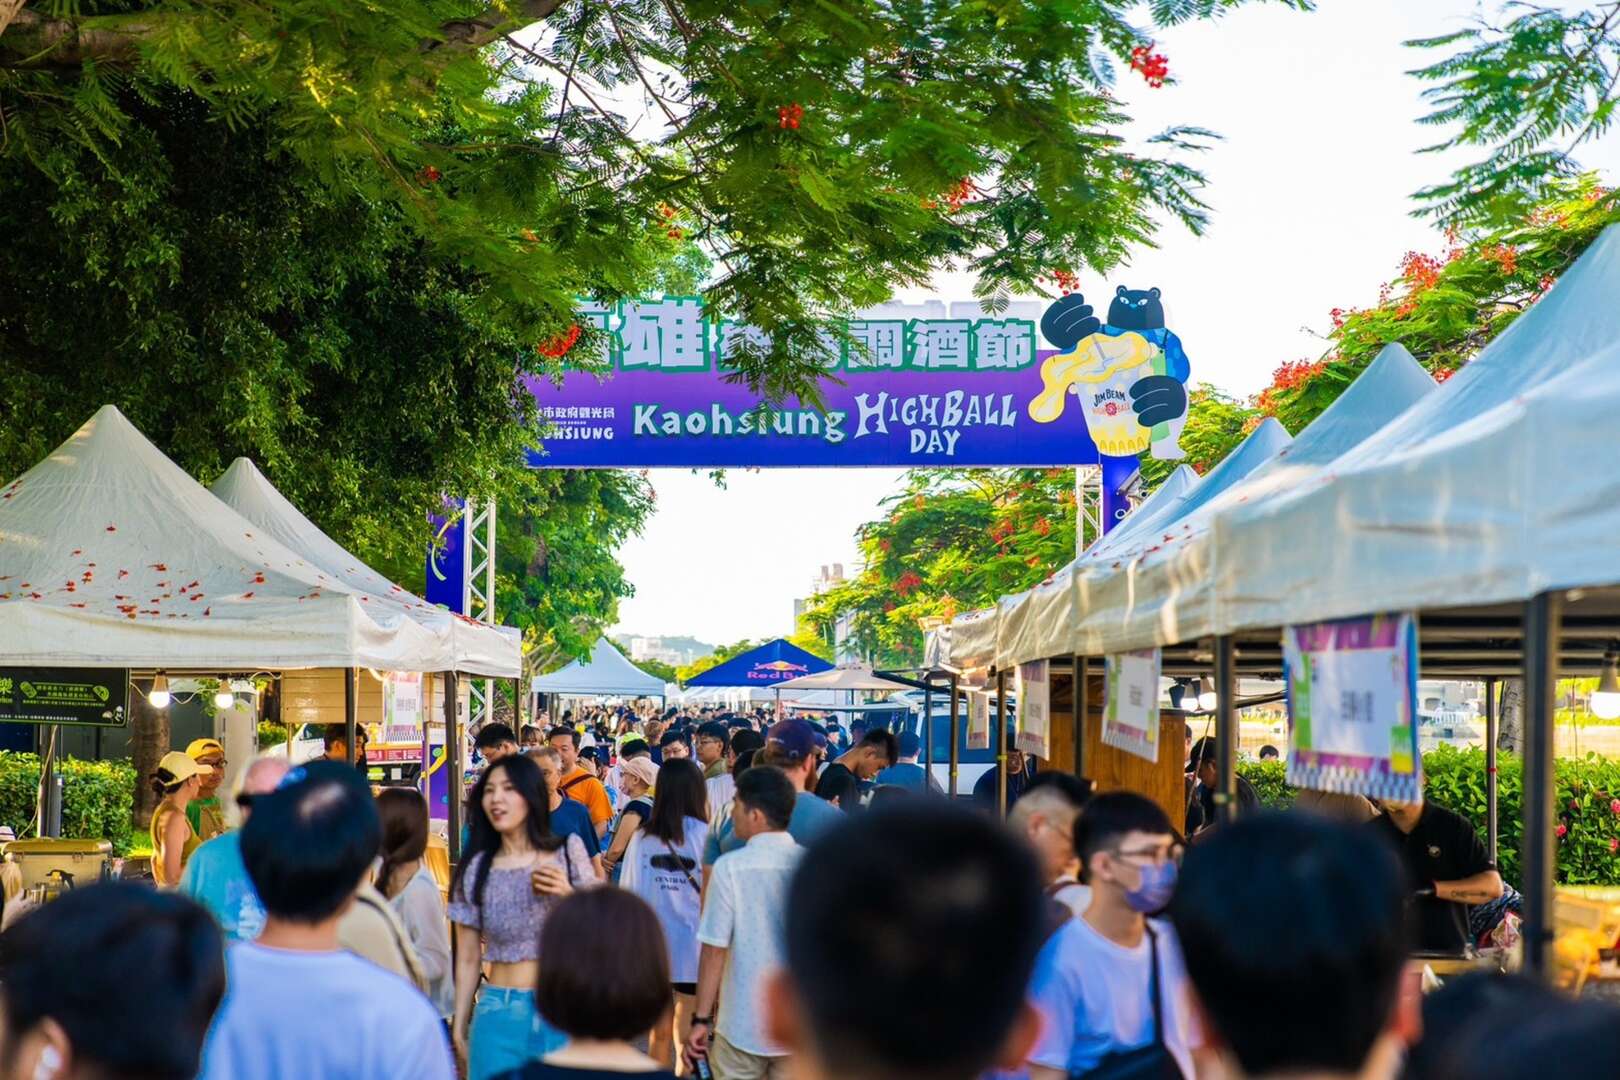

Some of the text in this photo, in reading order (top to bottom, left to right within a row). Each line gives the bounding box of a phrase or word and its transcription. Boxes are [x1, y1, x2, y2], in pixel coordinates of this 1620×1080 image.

[566, 296, 1036, 371] 雄調酒節
[1106, 389, 1126, 401] BEAM
[538, 406, 615, 418] 市政府觀光局
[633, 403, 846, 443] Kaohsiung
[909, 429, 961, 455] DAY
[747, 671, 780, 679] Red
